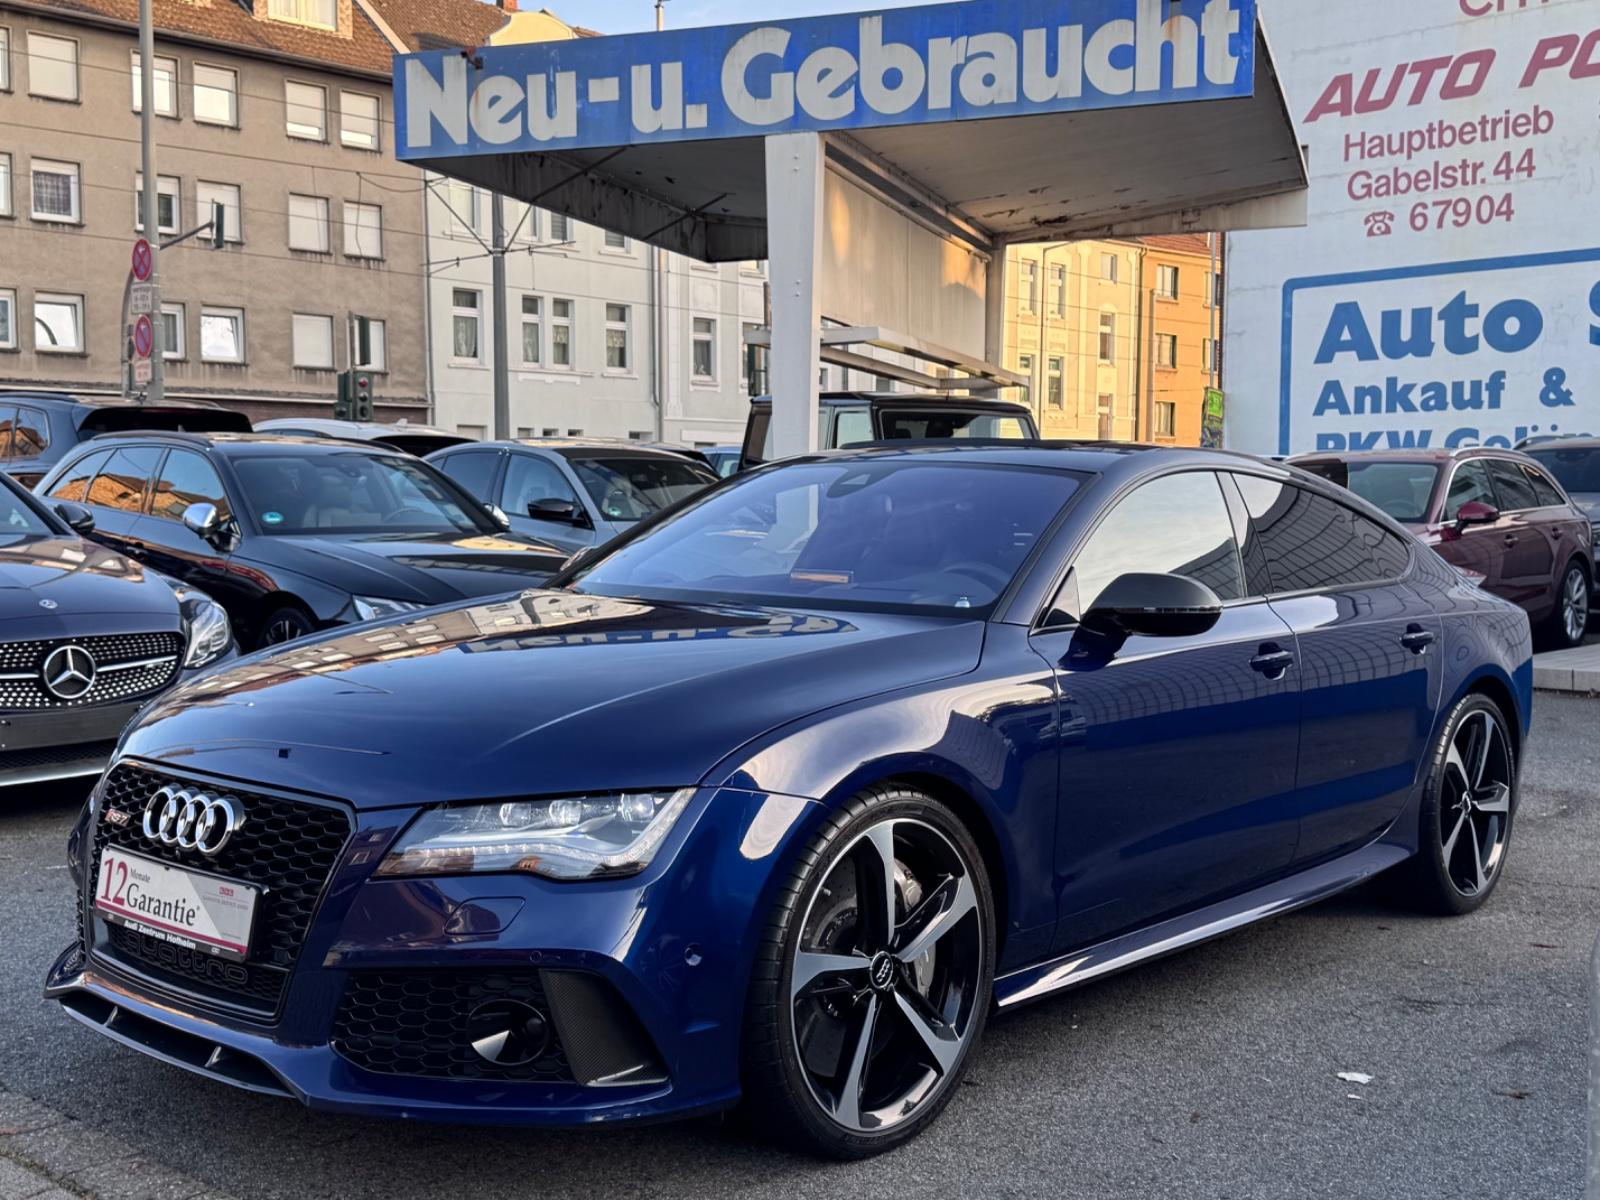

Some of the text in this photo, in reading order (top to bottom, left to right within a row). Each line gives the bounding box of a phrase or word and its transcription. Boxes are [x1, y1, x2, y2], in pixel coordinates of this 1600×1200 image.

[721, 0, 1240, 127] Gebraucht
[1304, 48, 1496, 123] AUTO
[1343, 105, 1554, 162] Hauptbetrieb
[1347, 148, 1536, 201] Gabelstr. 44
[1409, 193, 1515, 232] 67904
[1312, 289, 1544, 365] Auto
[1312, 366, 1576, 417] Ankauf &
[101, 857, 128, 907] 12
